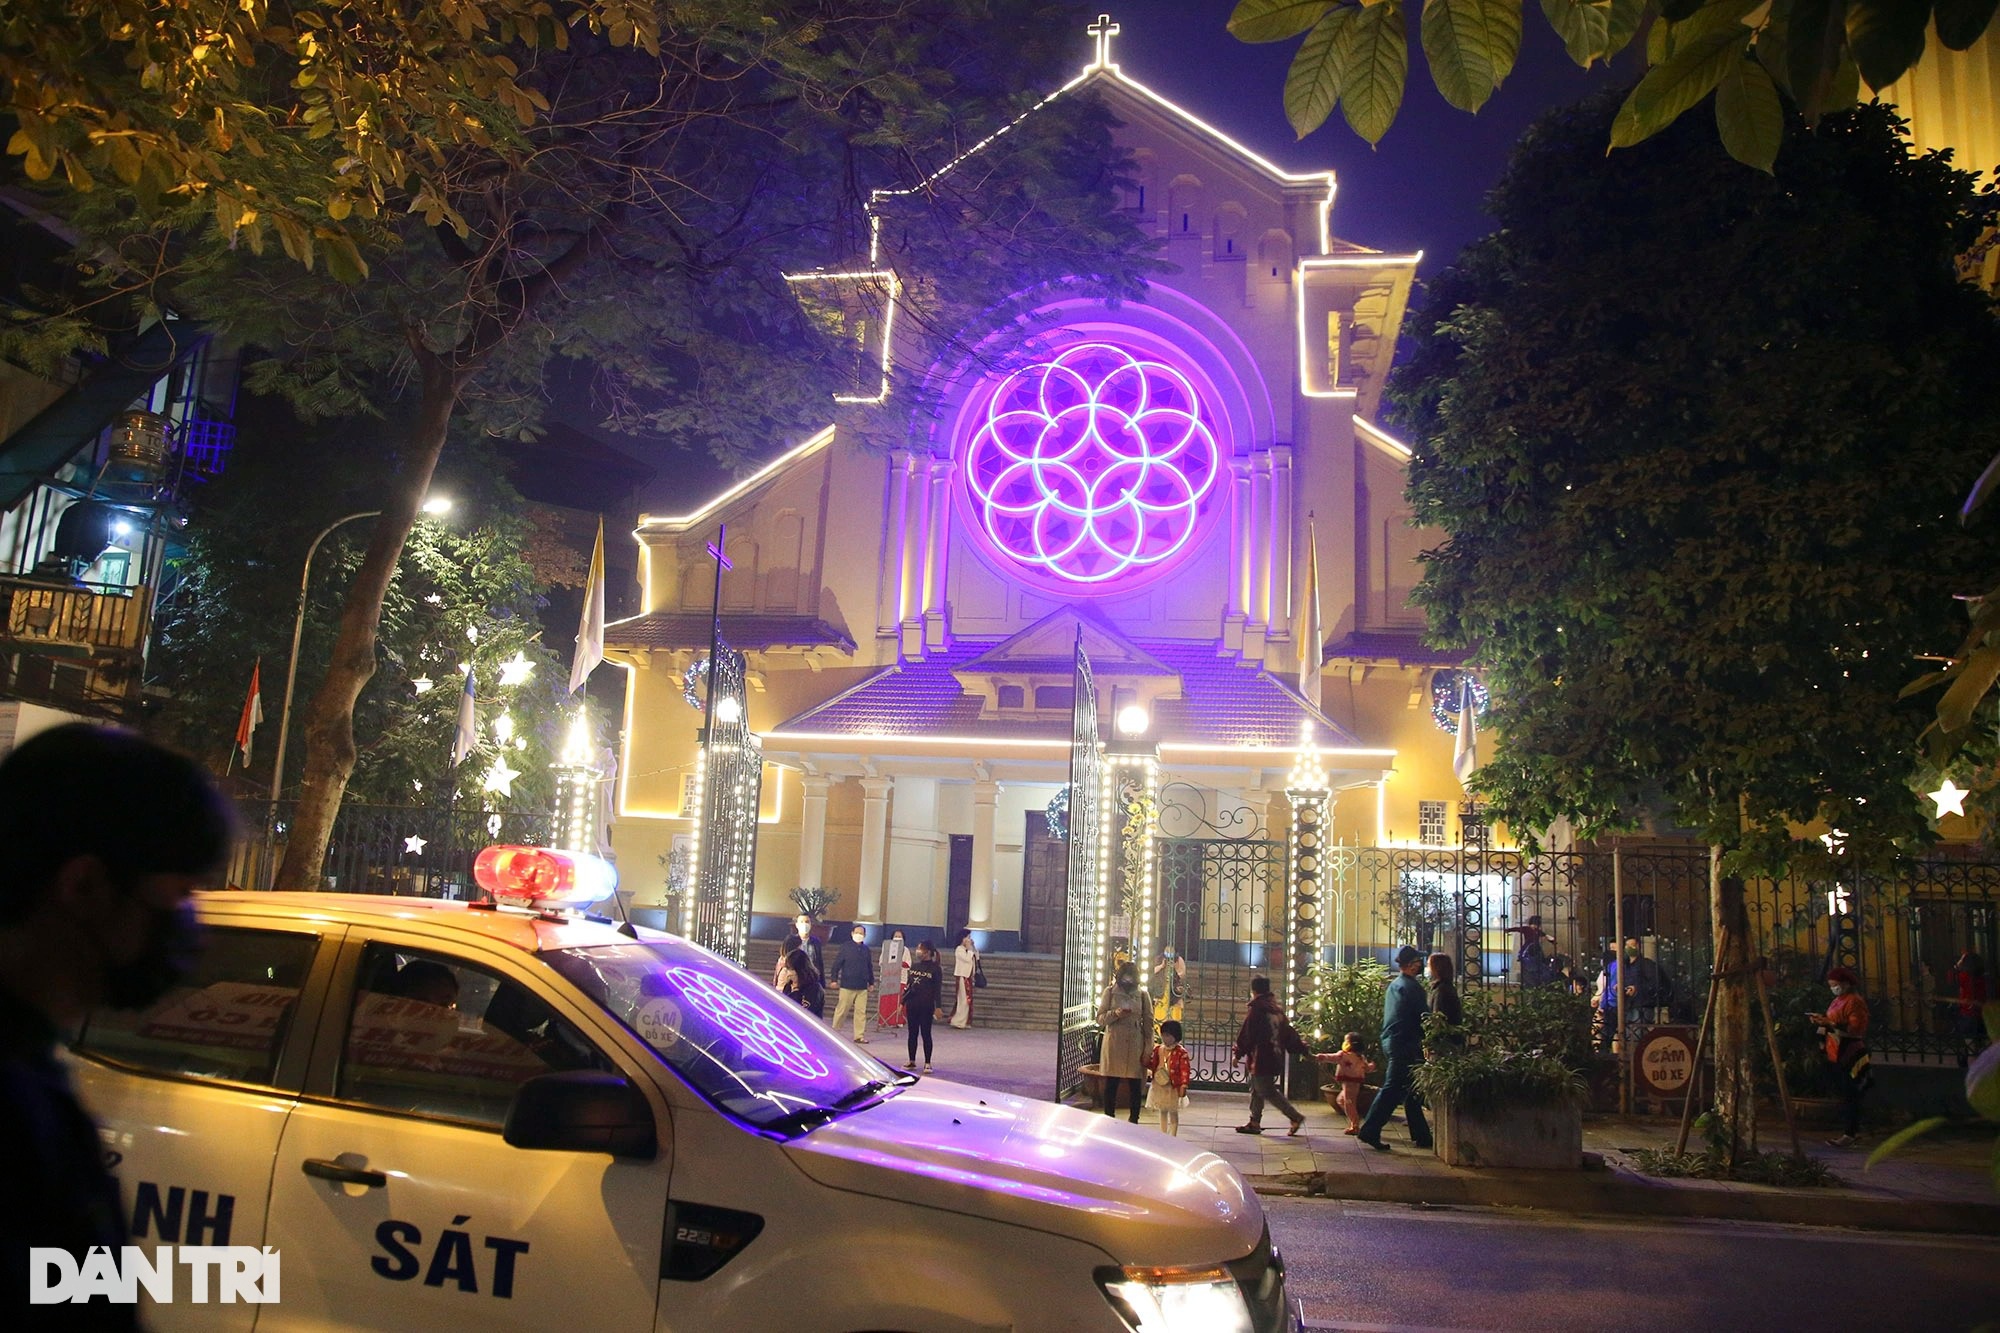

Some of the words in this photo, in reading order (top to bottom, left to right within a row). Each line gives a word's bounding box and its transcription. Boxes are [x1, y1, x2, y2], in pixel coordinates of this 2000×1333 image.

[641, 1006, 677, 1027] CẤM
[660, 1031, 673, 1042] XE
[1649, 1044, 1685, 1063] CẤM
[1670, 1068, 1684, 1080] XE
[371, 1215, 530, 1299] SÁT
